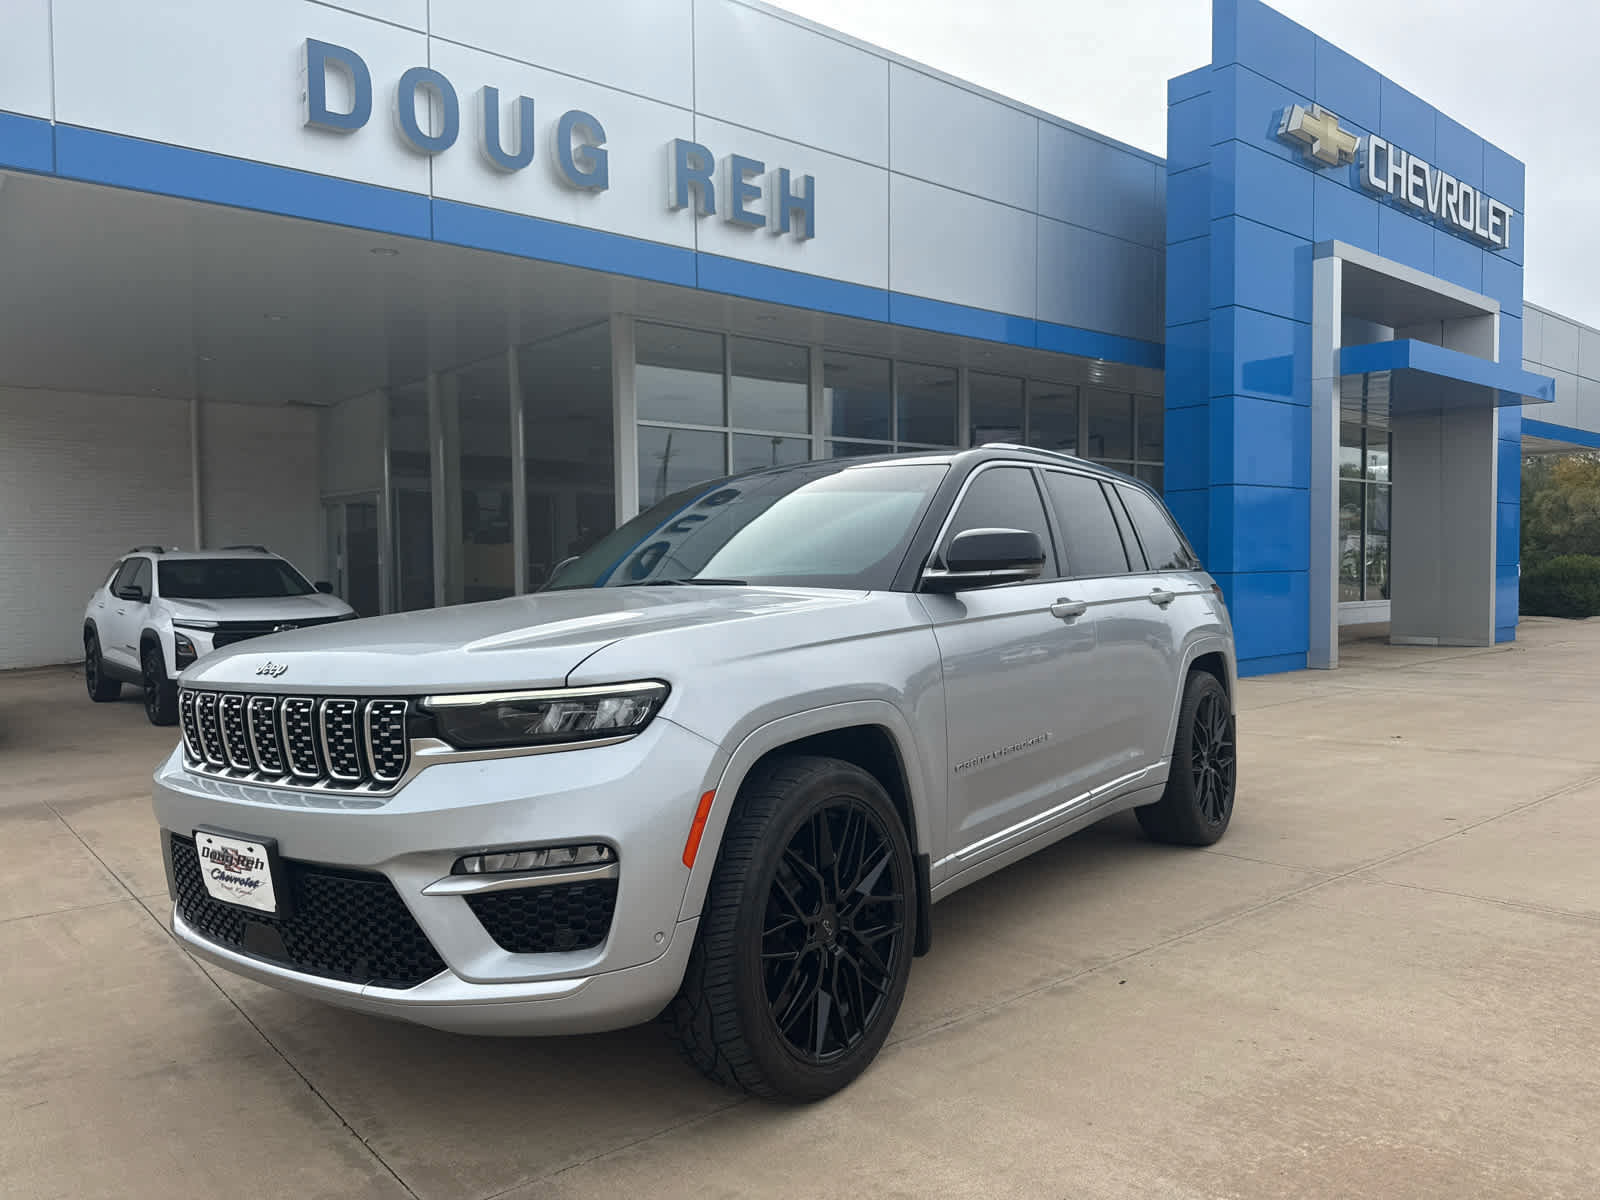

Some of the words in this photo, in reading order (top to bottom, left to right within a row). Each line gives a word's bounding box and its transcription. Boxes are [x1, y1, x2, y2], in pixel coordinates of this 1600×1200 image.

[303, 38, 609, 193] DOUG
[665, 138, 816, 241] REH
[1366, 135, 1514, 250] CHEVROLET
[255, 660, 289, 679] Jeep
[211, 868, 261, 889] Chevrolet
